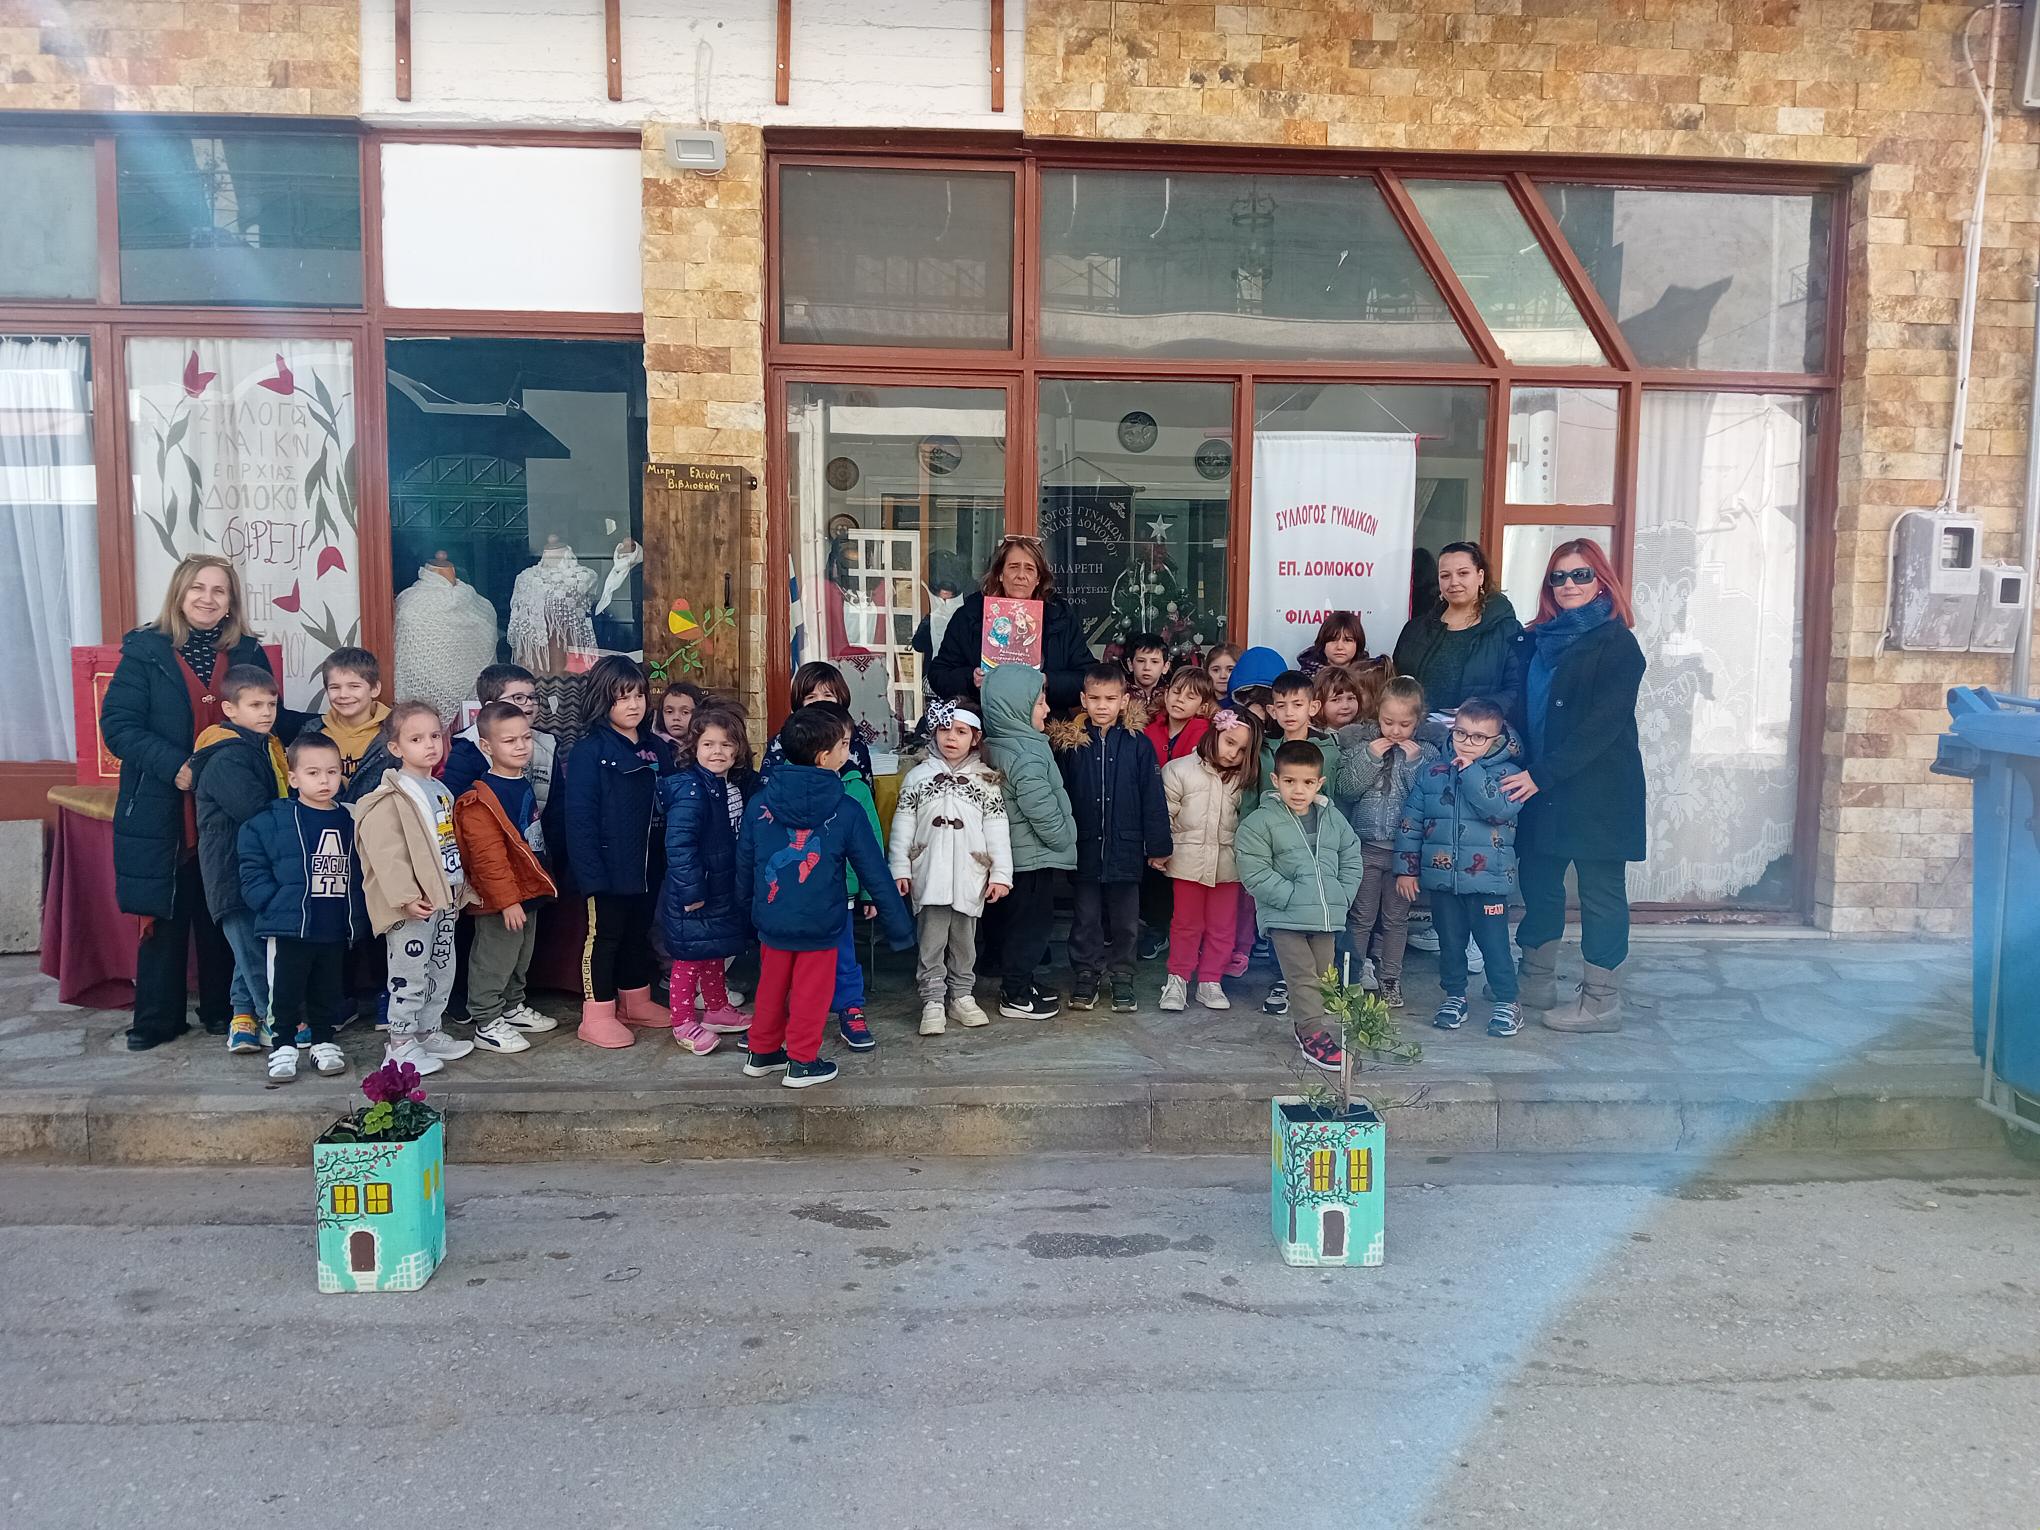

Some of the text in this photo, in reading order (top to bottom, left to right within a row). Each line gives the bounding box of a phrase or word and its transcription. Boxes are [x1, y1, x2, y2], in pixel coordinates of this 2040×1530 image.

[1276, 504, 1378, 536] ΣΥΛΛΟΓΟΣ ΓΥΝΑΙΚΩΝ
[1279, 561, 1374, 577] ΕΠ. ΔΟΜΟΚΟΥ
[1063, 597, 1087, 605] 008
[1484, 904, 1504, 915] TEAM
